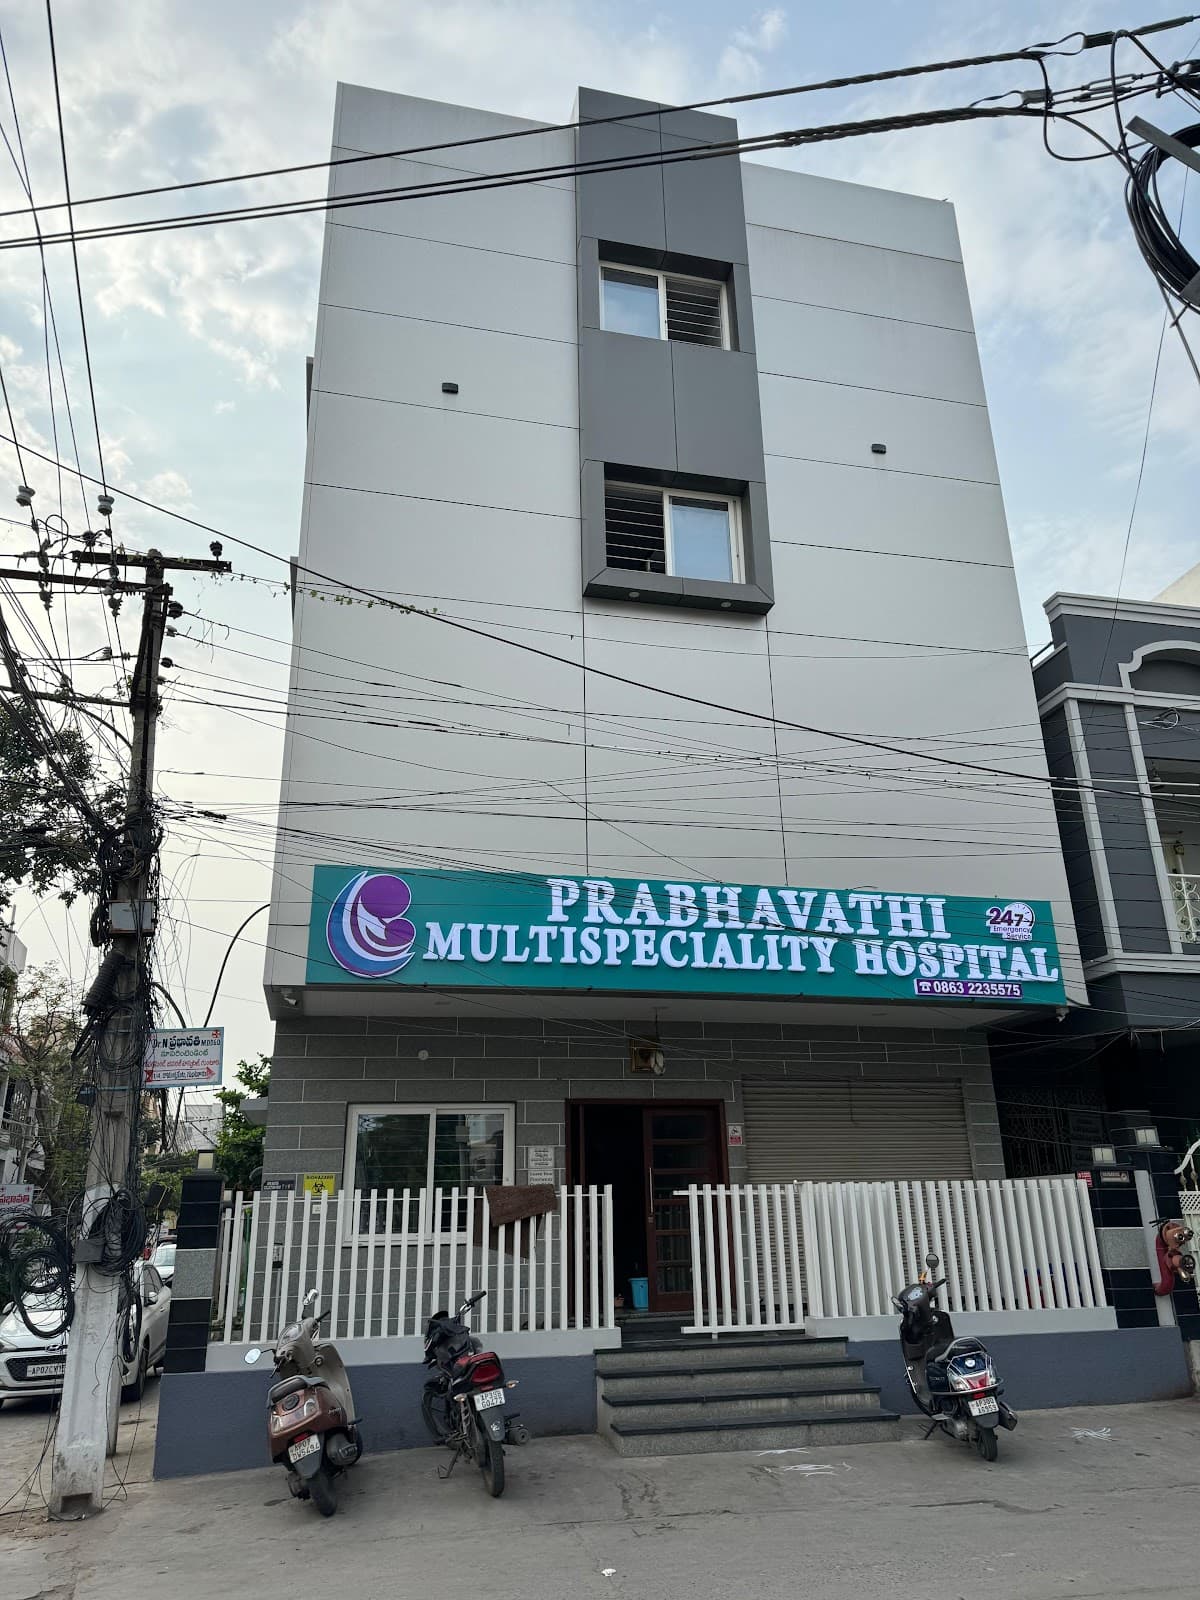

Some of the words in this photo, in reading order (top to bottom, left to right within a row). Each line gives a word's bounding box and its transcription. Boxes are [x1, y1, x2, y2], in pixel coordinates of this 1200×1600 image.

[546, 878, 952, 939] PRABHAVATHI
[993, 926, 1030, 934] Emergency
[422, 921, 838, 974] MULTISPECIALITY
[852, 938, 1059, 982] HOSPITAL
[933, 981, 964, 994] 0863
[967, 983, 1021, 996] 2235575
